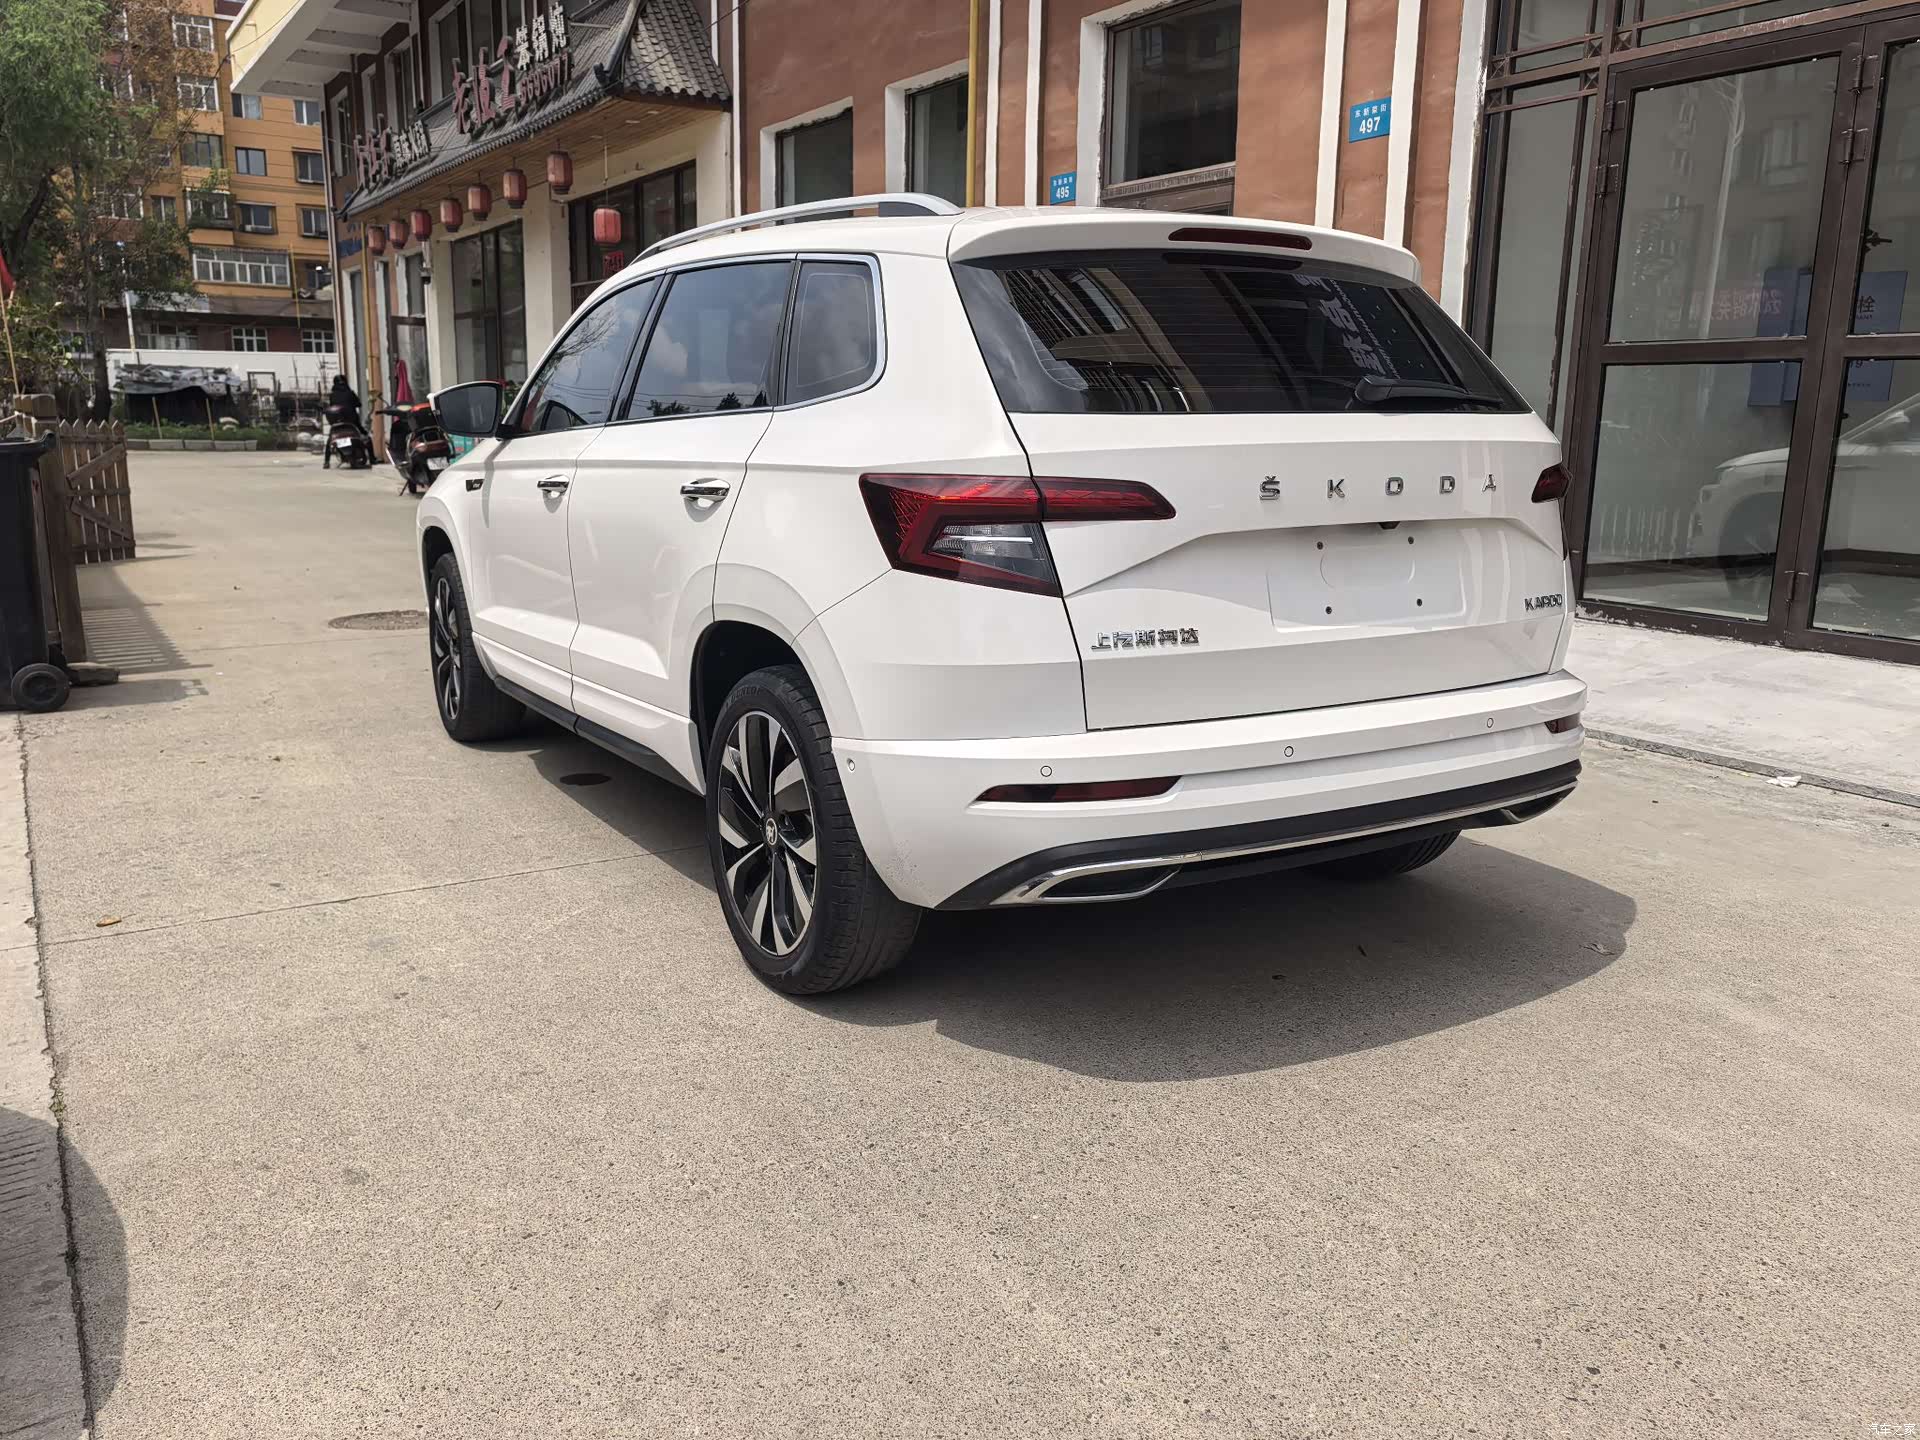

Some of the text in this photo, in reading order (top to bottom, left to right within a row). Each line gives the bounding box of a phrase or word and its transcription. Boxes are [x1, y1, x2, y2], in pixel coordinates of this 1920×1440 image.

[1359, 116, 1381, 134] 497
[1055, 186, 1070, 200] 495
[1259, 474, 1497, 501] ŠKODA
[1091, 627, 1200, 650] 上汽斯柯达
